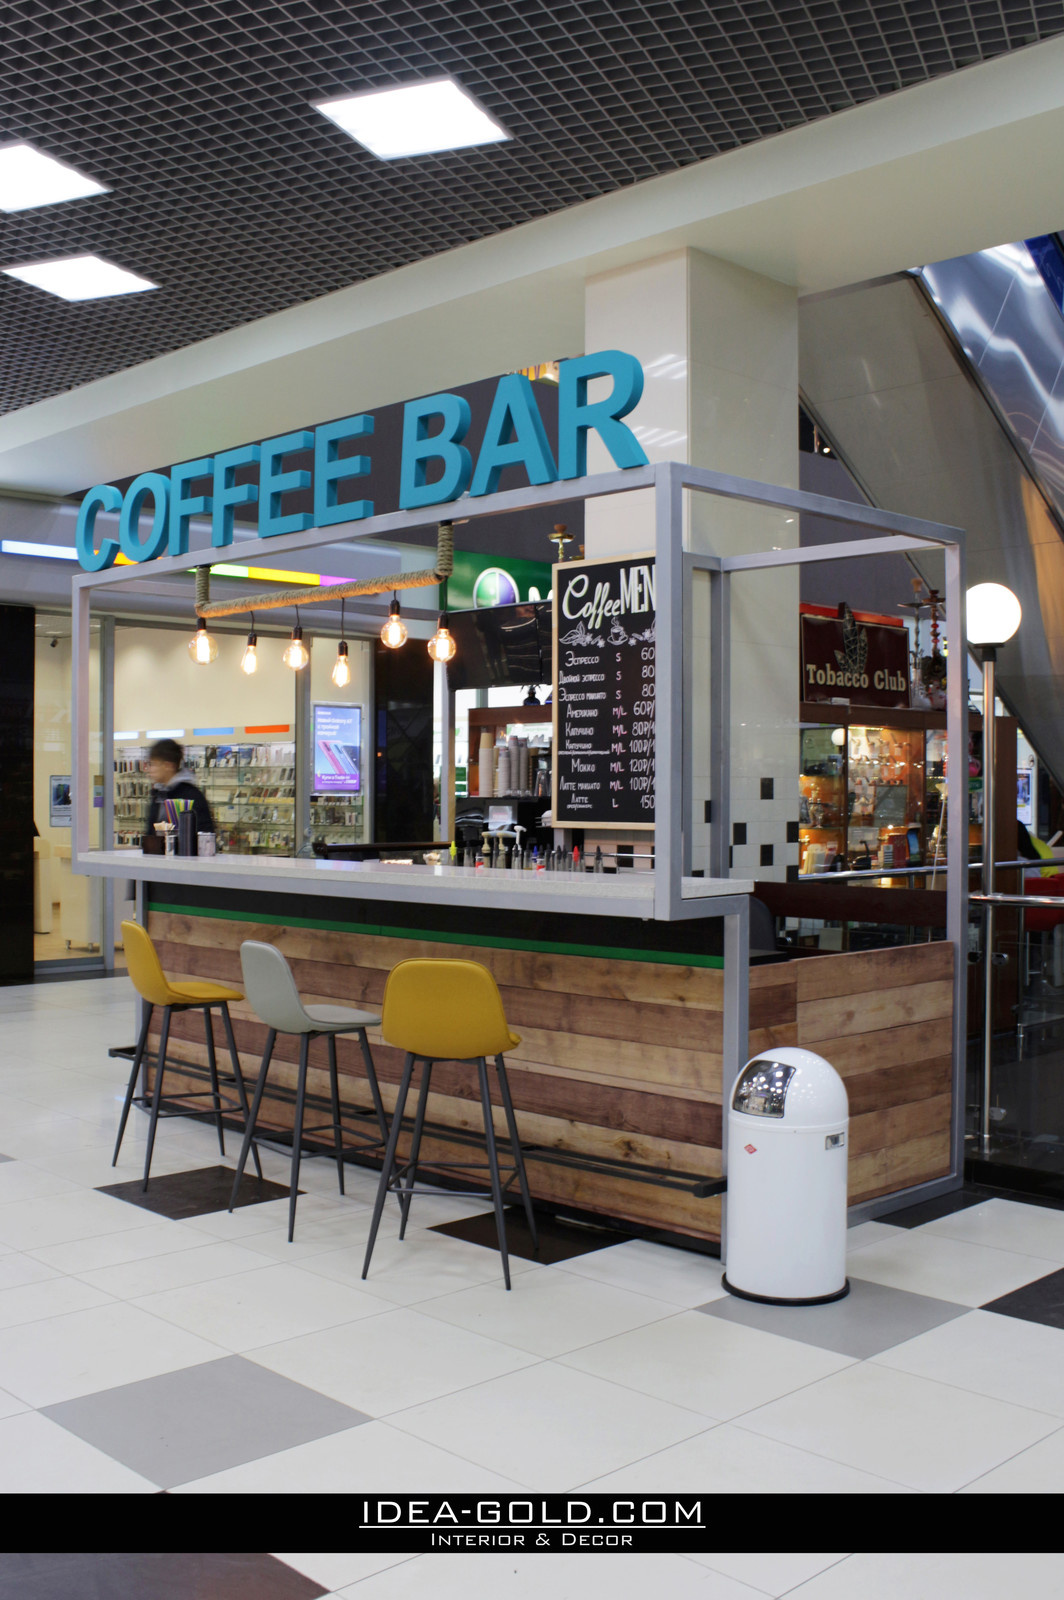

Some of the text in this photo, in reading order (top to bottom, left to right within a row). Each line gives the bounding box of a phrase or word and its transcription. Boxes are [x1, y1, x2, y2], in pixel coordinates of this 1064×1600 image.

[75, 349, 650, 572] COFFEE BAR
[562, 574, 621, 629] Coffee
[616, 653, 621, 662] S
[616, 671, 621, 680] S
[806, 663, 906, 692] Tobacco Club
[616, 690, 621, 699] S
[613, 799, 618, 807] L
